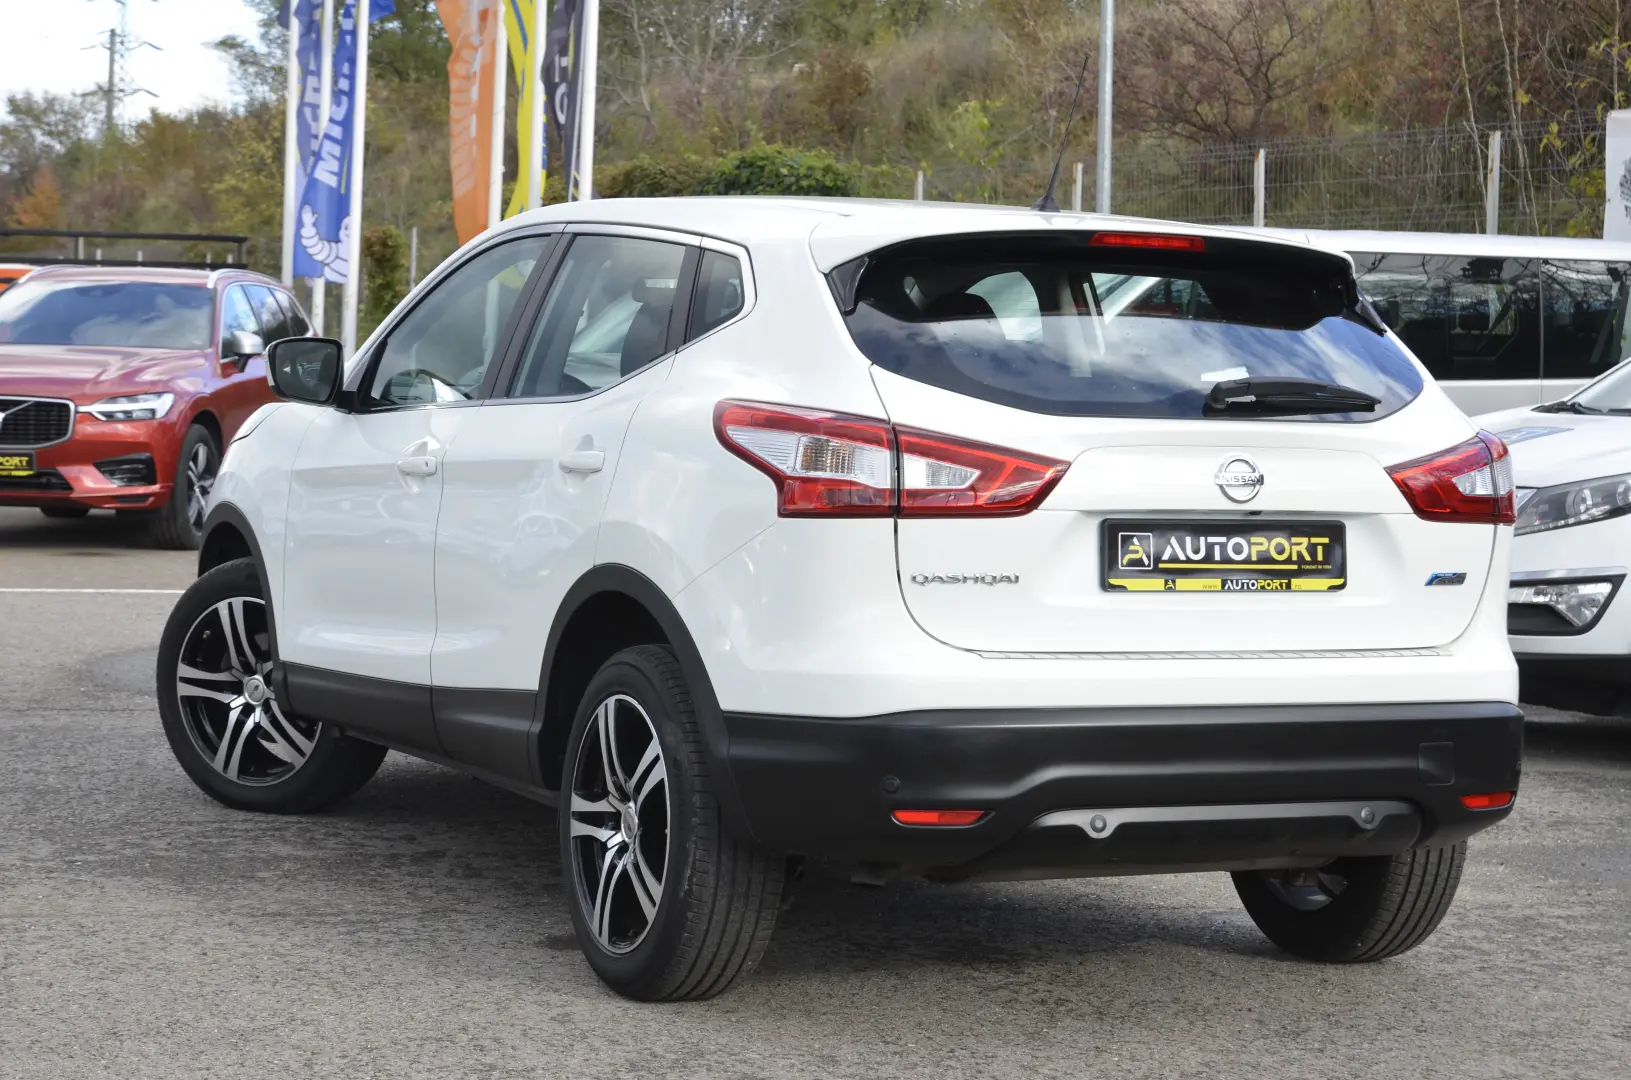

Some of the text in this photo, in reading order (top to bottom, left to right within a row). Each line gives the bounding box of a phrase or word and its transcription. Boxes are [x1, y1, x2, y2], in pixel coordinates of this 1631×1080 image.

[1221, 475, 1261, 483] NISSAN
[1161, 536, 1330, 561] AUTOPORT
[911, 572, 1020, 586] QASHQAI
[1224, 579, 1288, 590] AUTOPORT
